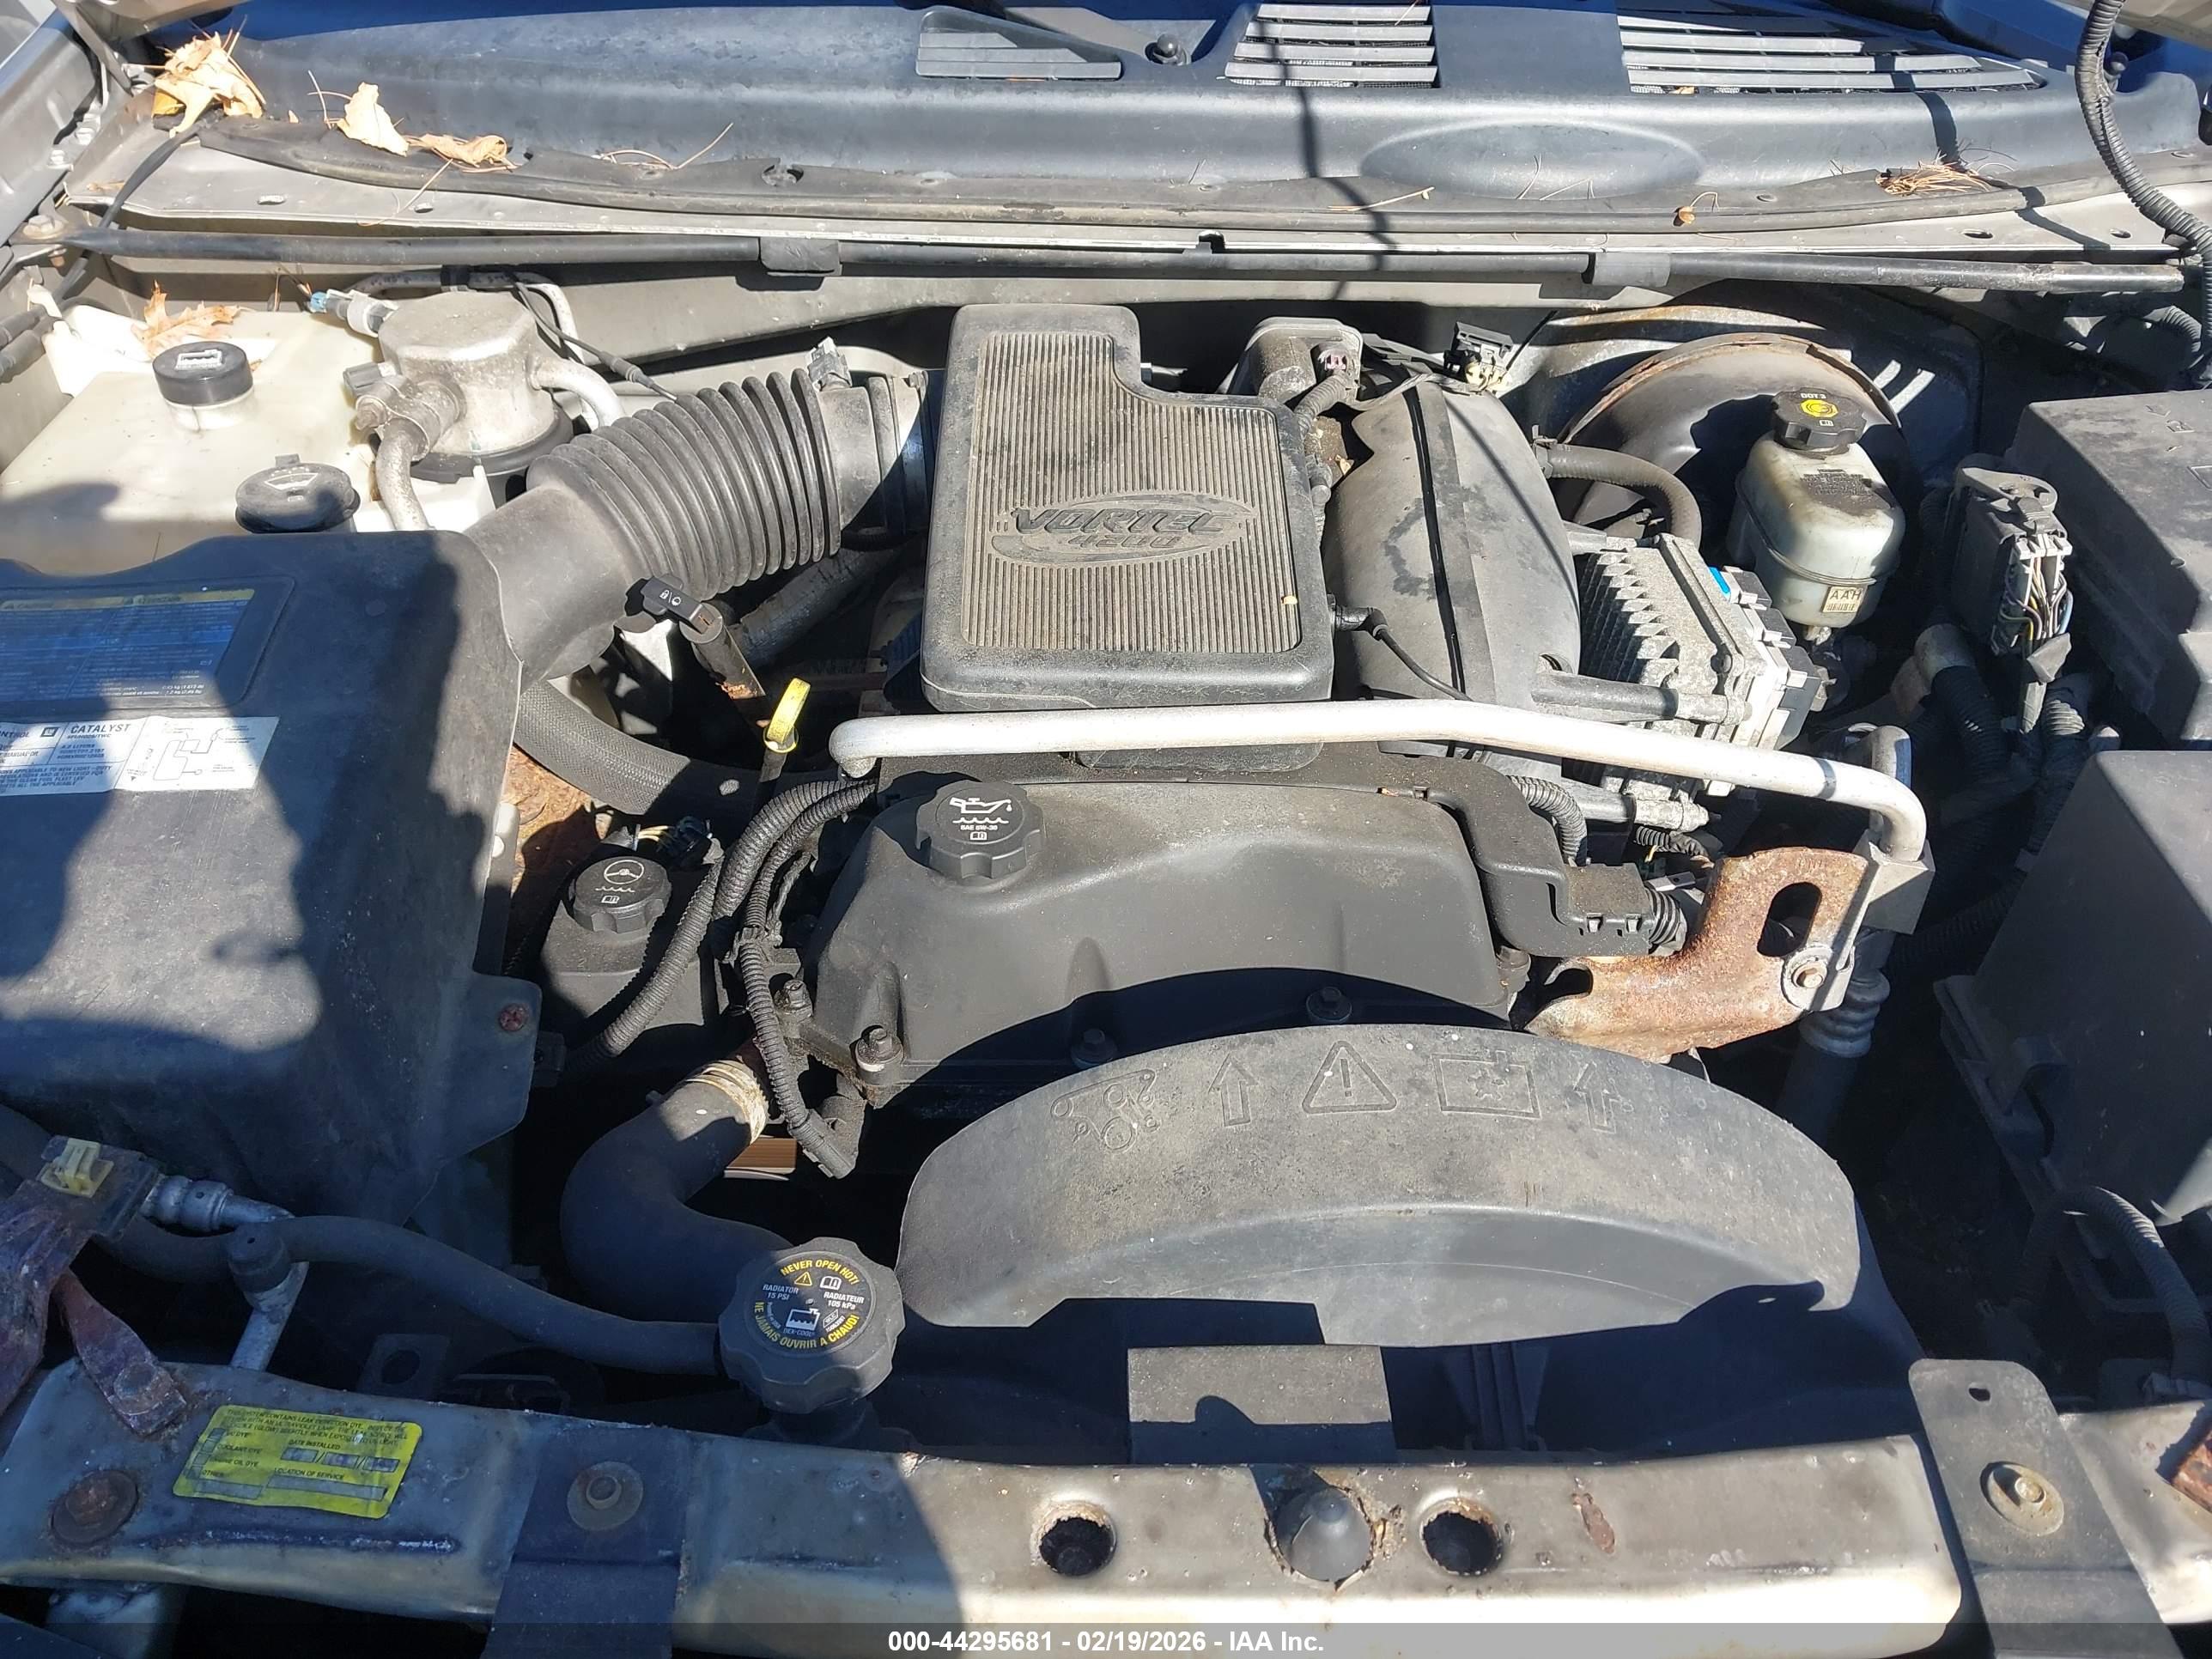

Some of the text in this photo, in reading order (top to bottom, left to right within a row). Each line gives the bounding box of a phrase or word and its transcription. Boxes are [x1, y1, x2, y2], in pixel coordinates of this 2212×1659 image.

[1011, 507, 1231, 534] VORTEC
[1067, 534, 1182, 549] 4200
[1829, 589, 1863, 600] AAH
[70, 723, 131, 733] CATALYST
[781, 1259, 860, 1285] NEVER OPEN HOT!
[763, 1284, 799, 1295] RADIATOR
[823, 1291, 865, 1304] RADIATEUR
[754, 1301, 765, 1314] NE
[828, 1299, 856, 1310] 105 kPa
[755, 1313, 780, 1342] JAMAIS
[828, 1313, 860, 1343] CHAUD!
[780, 1336, 817, 1349] OUVRIR
[305, 1440, 342, 1450] INSTALLED
[273, 1467, 305, 1476] LOCATION
[316, 1471, 345, 1480] SERVICE
